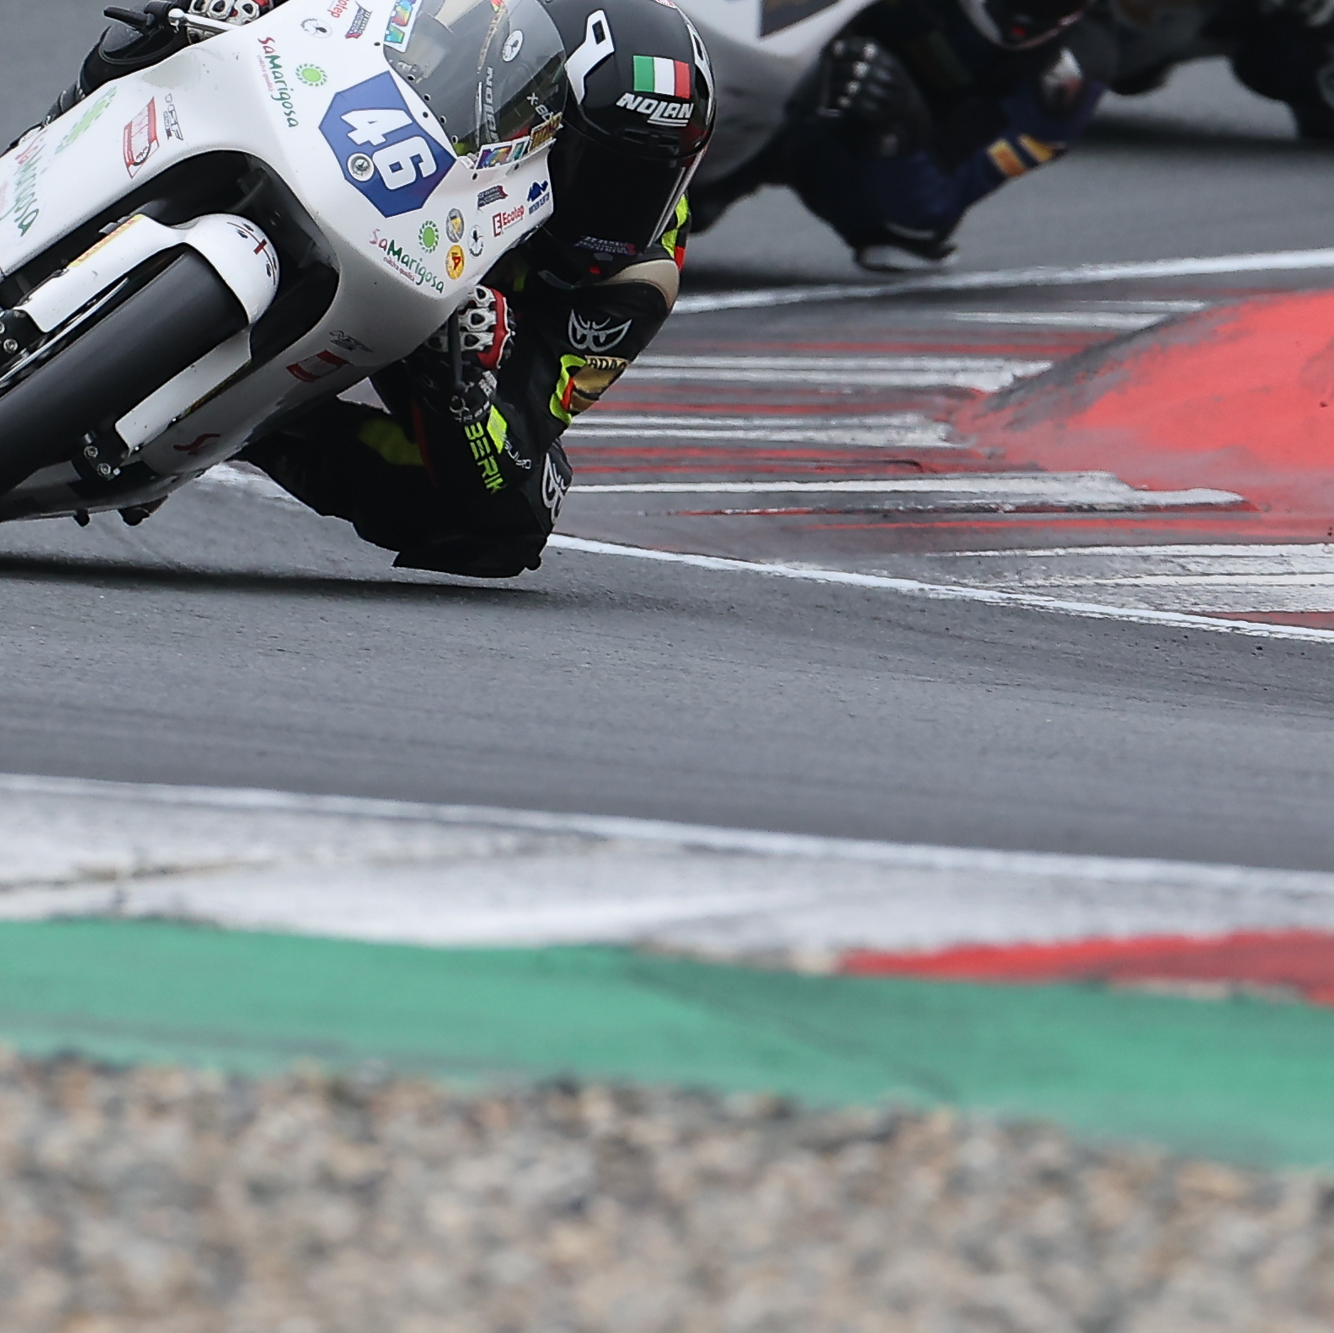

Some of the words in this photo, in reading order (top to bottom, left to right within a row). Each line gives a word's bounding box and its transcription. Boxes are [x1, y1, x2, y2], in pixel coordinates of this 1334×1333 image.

[616, 92, 694, 124] NOLAN
[340, 109, 437, 190] 46
[502, 205, 525, 225] Ecotep
